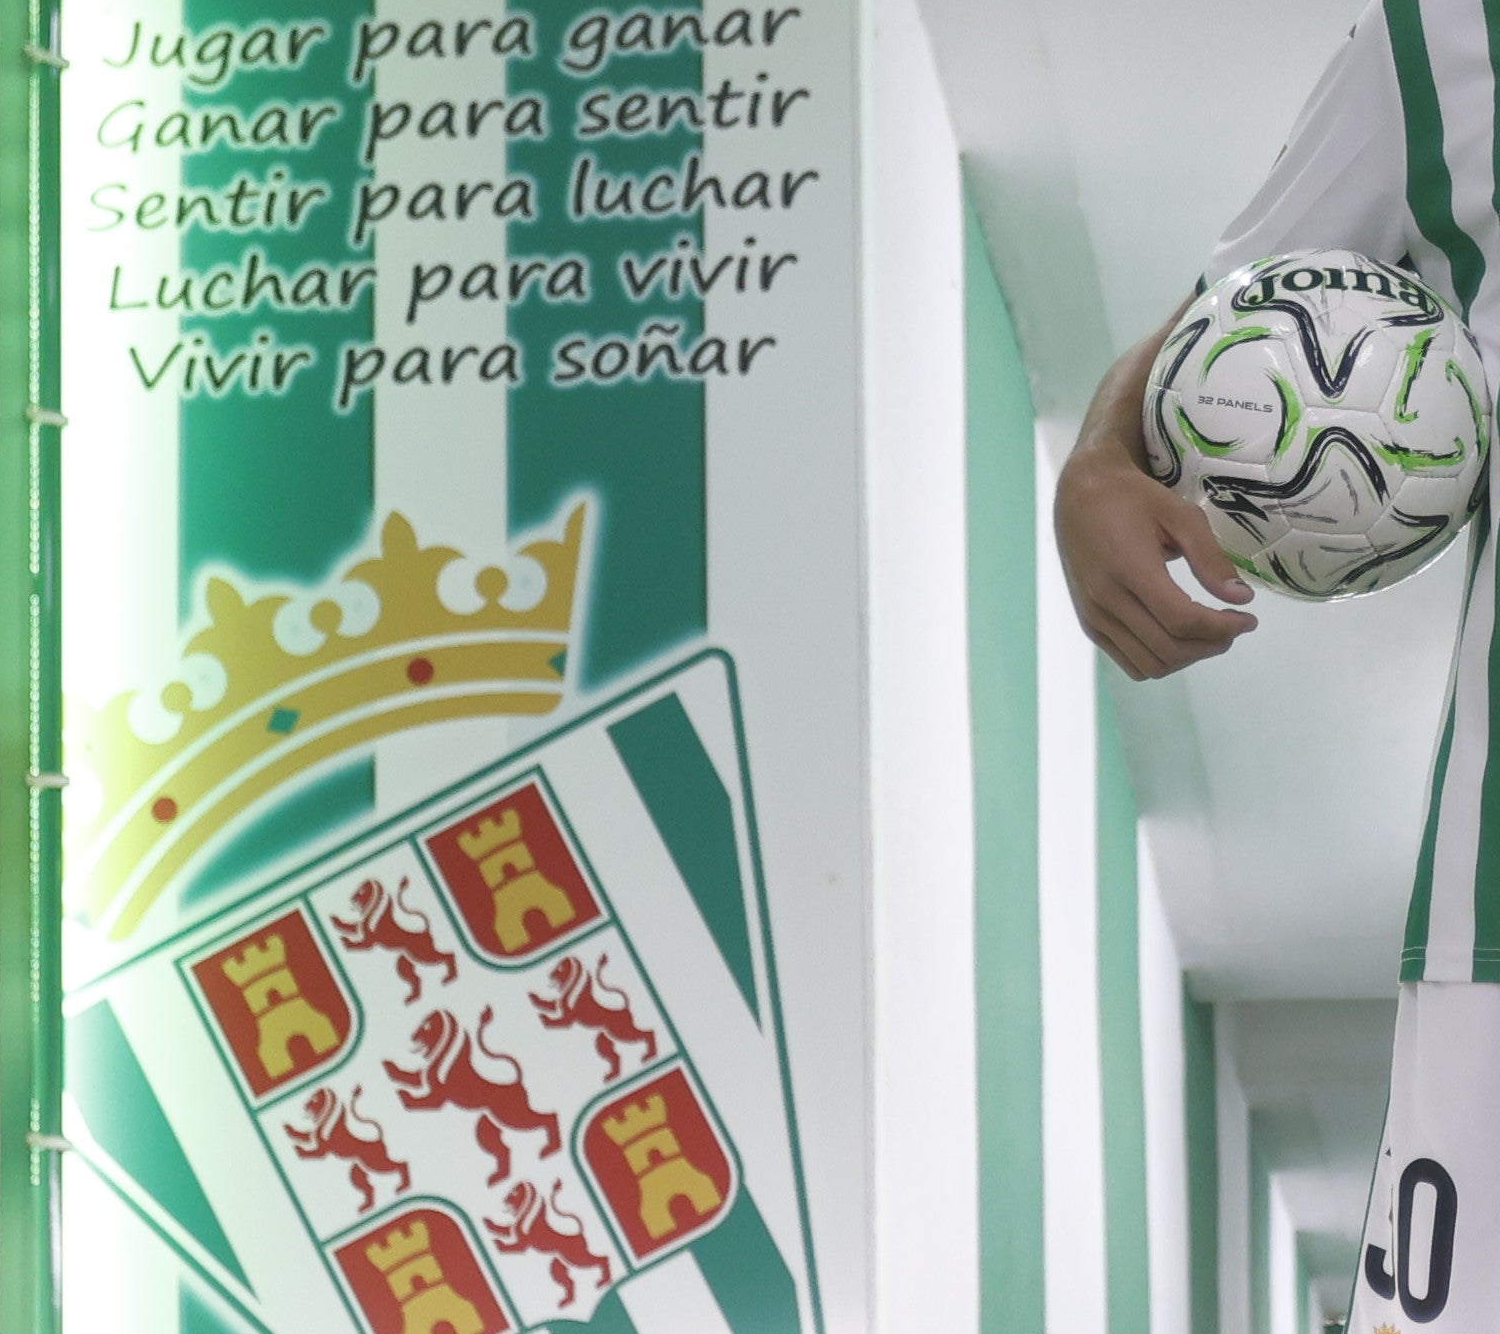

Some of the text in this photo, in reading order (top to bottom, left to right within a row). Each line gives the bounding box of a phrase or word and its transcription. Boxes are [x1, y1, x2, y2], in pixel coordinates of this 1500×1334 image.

[103, 7, 800, 86] Jugar para ganar
[98, 72, 810, 163] Ganar para sentir
[86, 157, 819, 244] Sentir para luchar
[110, 236, 797, 324] Luchar para vivir
[130, 322, 776, 408] Vivir para soñar
[1197, 395, 1274, 413] 32 PANELS
